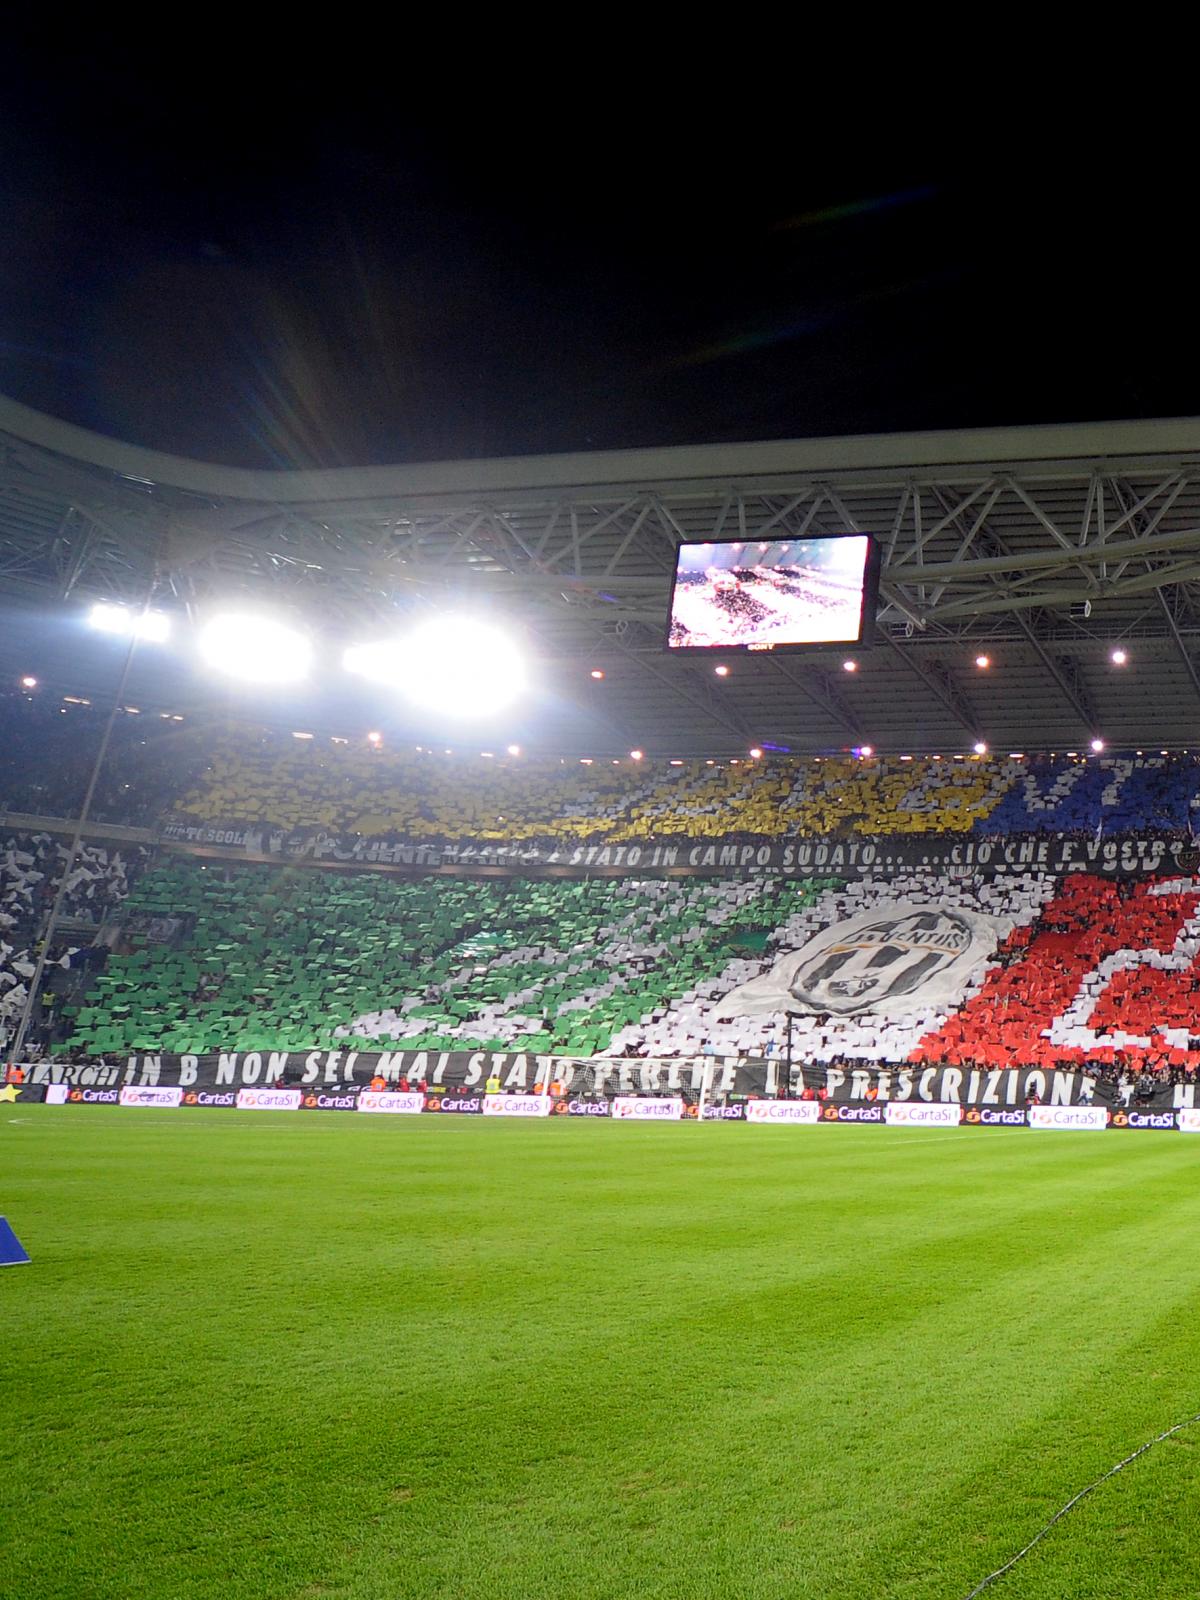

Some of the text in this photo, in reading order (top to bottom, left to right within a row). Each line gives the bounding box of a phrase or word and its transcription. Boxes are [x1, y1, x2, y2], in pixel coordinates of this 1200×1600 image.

[747, 643, 775, 651] SONY
[569, 846, 642, 866] STATO
[652, 846, 680, 866] IN
[689, 845, 771, 866] CAMPO
[1004, 841, 1050, 863] CHE
[1087, 840, 1183, 860] VOSTRO
[124, 1055, 162, 1087] IN
[178, 1055, 200, 1086] B
[215, 1052, 290, 1084] NON
[374, 1051, 450, 1084] MAI
[82, 1089, 118, 1102] CartaSi
[197, 1091, 235, 1106] CartaSi
[255, 1093, 293, 1107] CartaSi
[317, 1095, 354, 1108] CartaSi
[378, 1096, 416, 1109] CartaSi
[440, 1096, 480, 1110] CartaSi
[568, 1100, 608, 1114] CartaSi
[769, 1105, 810, 1118] CartaSi
[838, 1107, 881, 1121] CartaSi
[909, 1107, 951, 1121] CartaSi
[980, 1109, 1025, 1123] CartaSi
[1054, 1111, 1097, 1124] CartaSi
[1127, 1112, 1174, 1127] CartaSi
